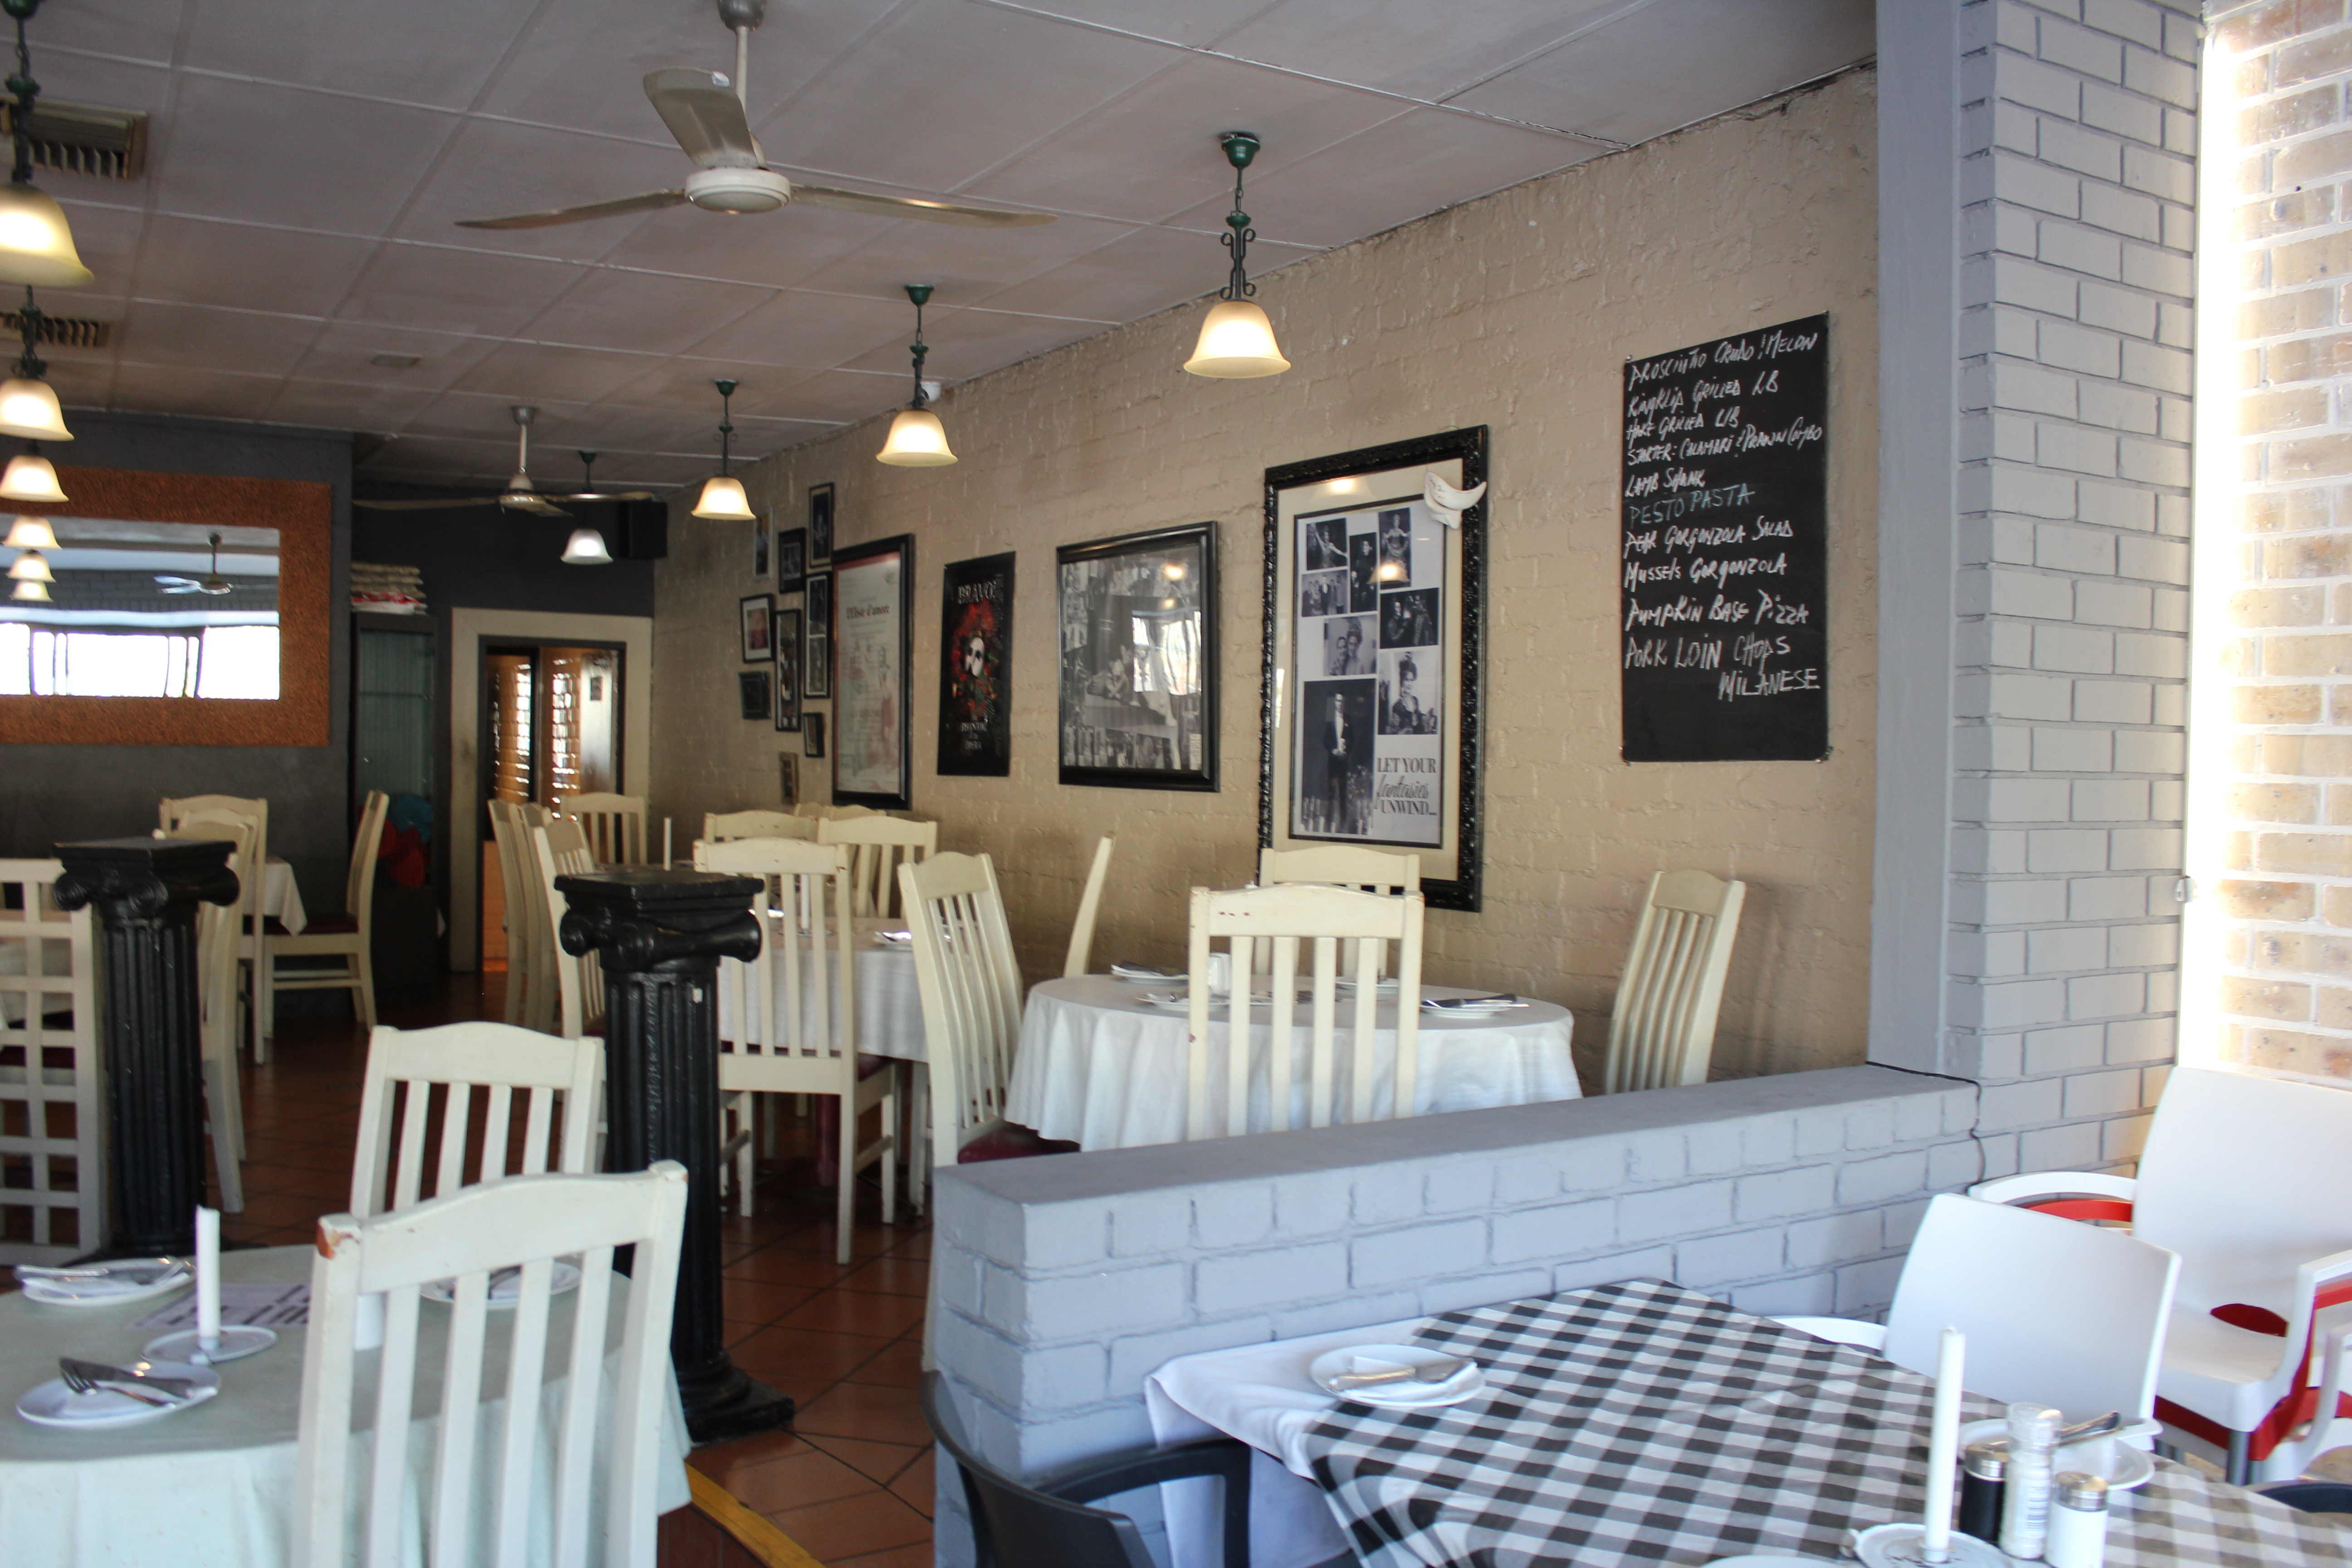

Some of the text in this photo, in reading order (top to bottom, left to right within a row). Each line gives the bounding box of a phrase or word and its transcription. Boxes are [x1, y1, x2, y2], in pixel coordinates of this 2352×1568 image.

[1629, 483, 1756, 529] PESTO PASTA
[1377, 757, 1437, 773] LET YOUR
